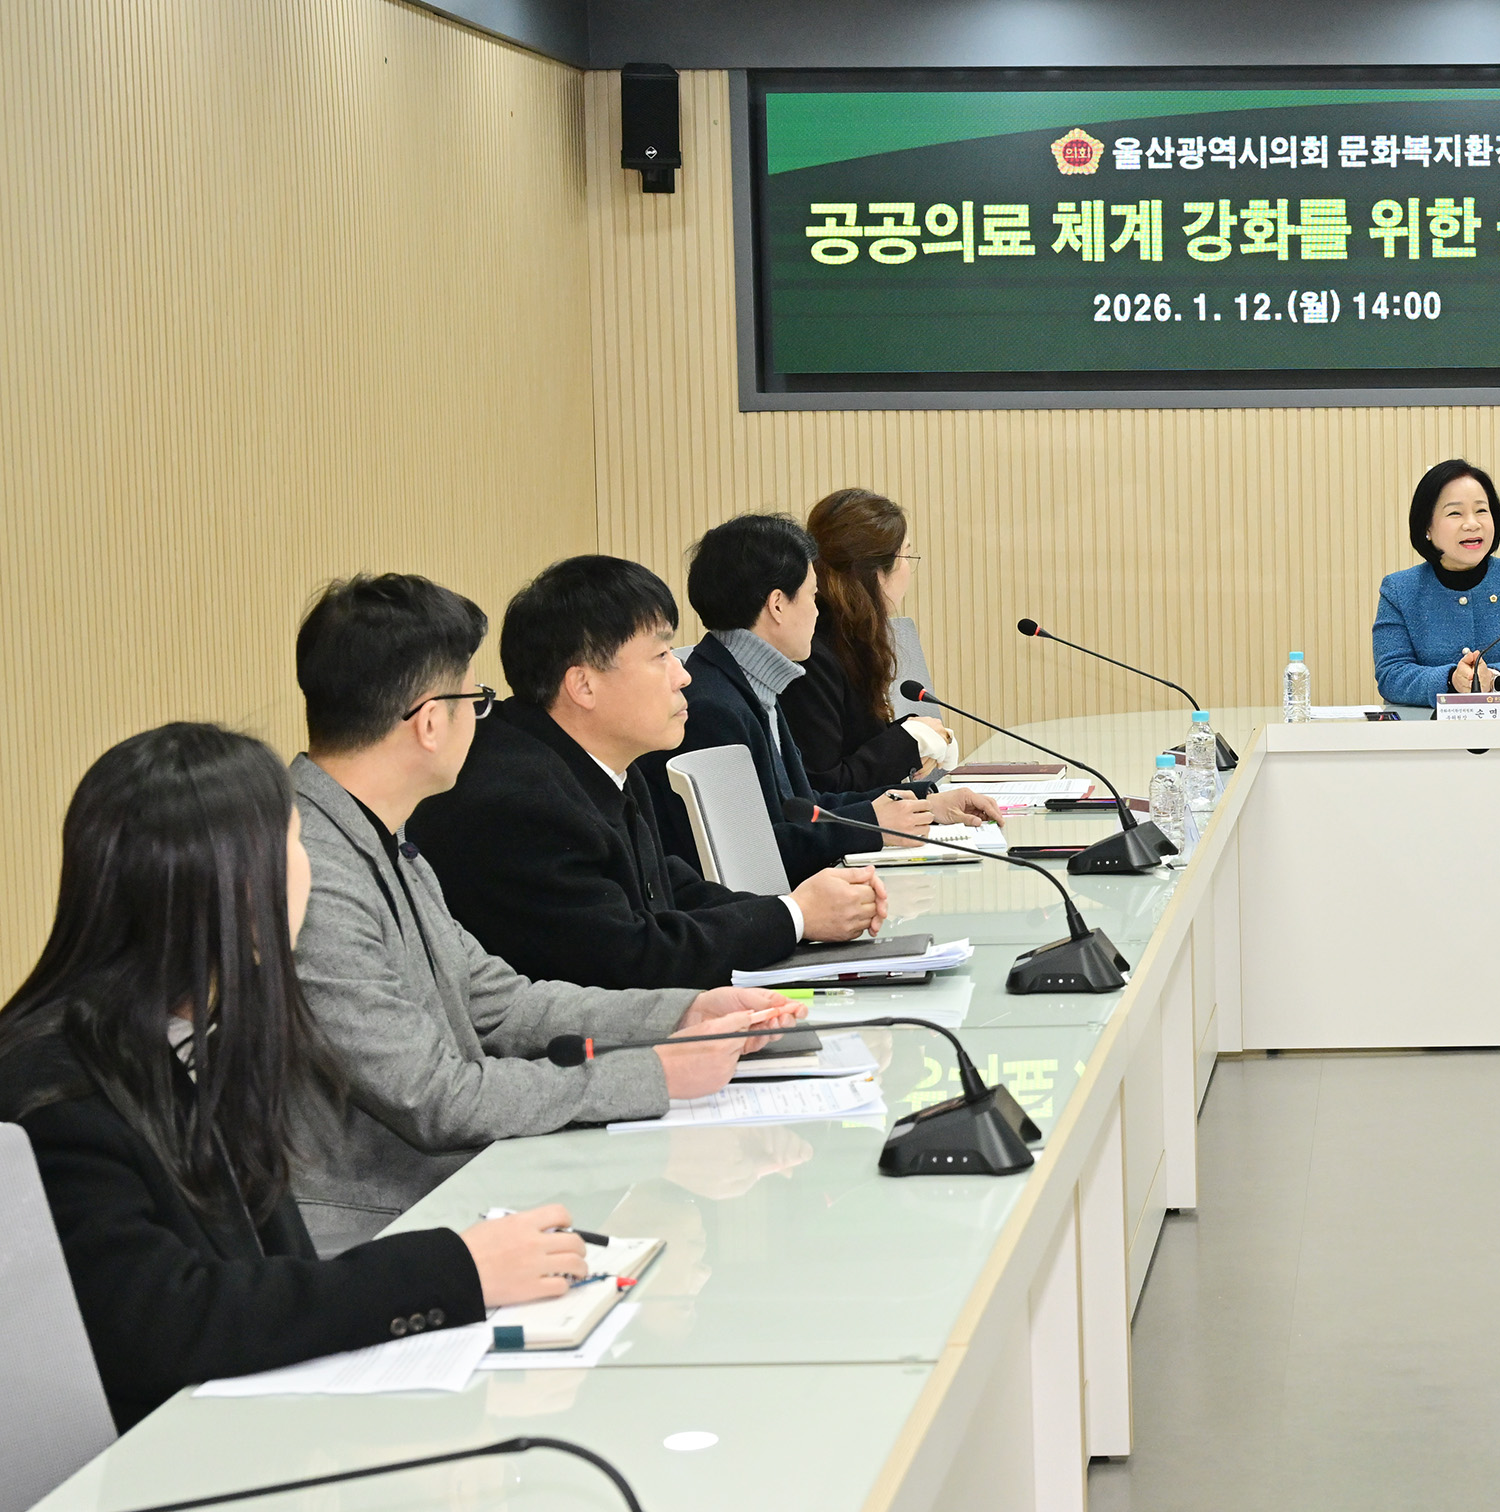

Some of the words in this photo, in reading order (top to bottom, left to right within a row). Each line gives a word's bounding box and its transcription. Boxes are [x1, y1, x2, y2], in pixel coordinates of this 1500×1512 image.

[1112, 135, 1329, 170] 울산광역시의회
[805, 200, 1036, 265] 공공의료
[1051, 199, 1163, 262] 체계
[1181, 198, 1352, 262] 강화를
[1368, 197, 1482, 260] 위한
[1093, 293, 1182, 323] 2026.
[1193, 293, 1222, 321] 1.
[1352, 291, 1442, 320] 14:00
